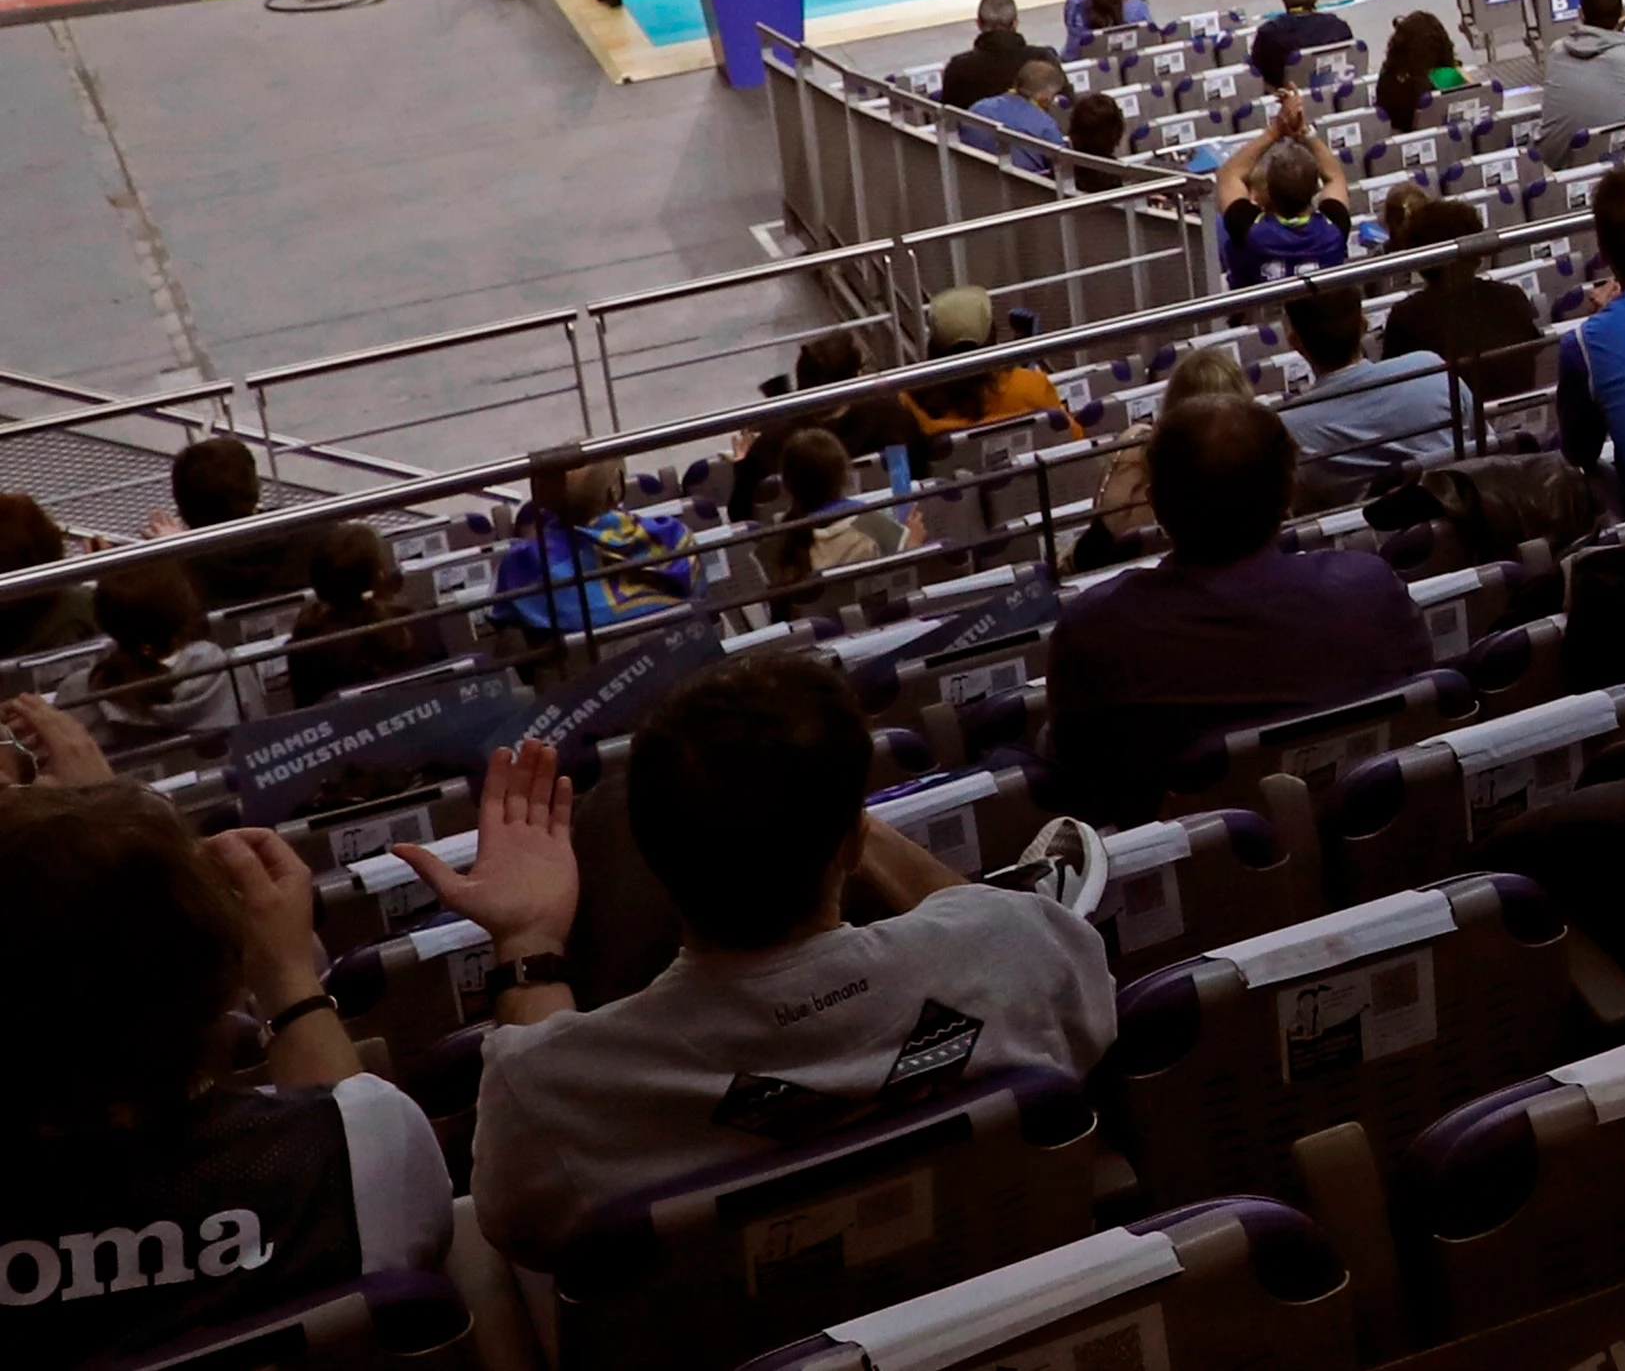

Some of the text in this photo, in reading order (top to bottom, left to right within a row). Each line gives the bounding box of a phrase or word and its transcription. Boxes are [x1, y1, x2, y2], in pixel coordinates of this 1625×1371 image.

[377, 700, 442, 736] ESTU!
[543, 694, 600, 748] ISTAR
[245, 720, 334, 770] ¡VAMOS
[255, 727, 376, 791] MOVISTAR
[774, 978, 869, 1027] blue banana
